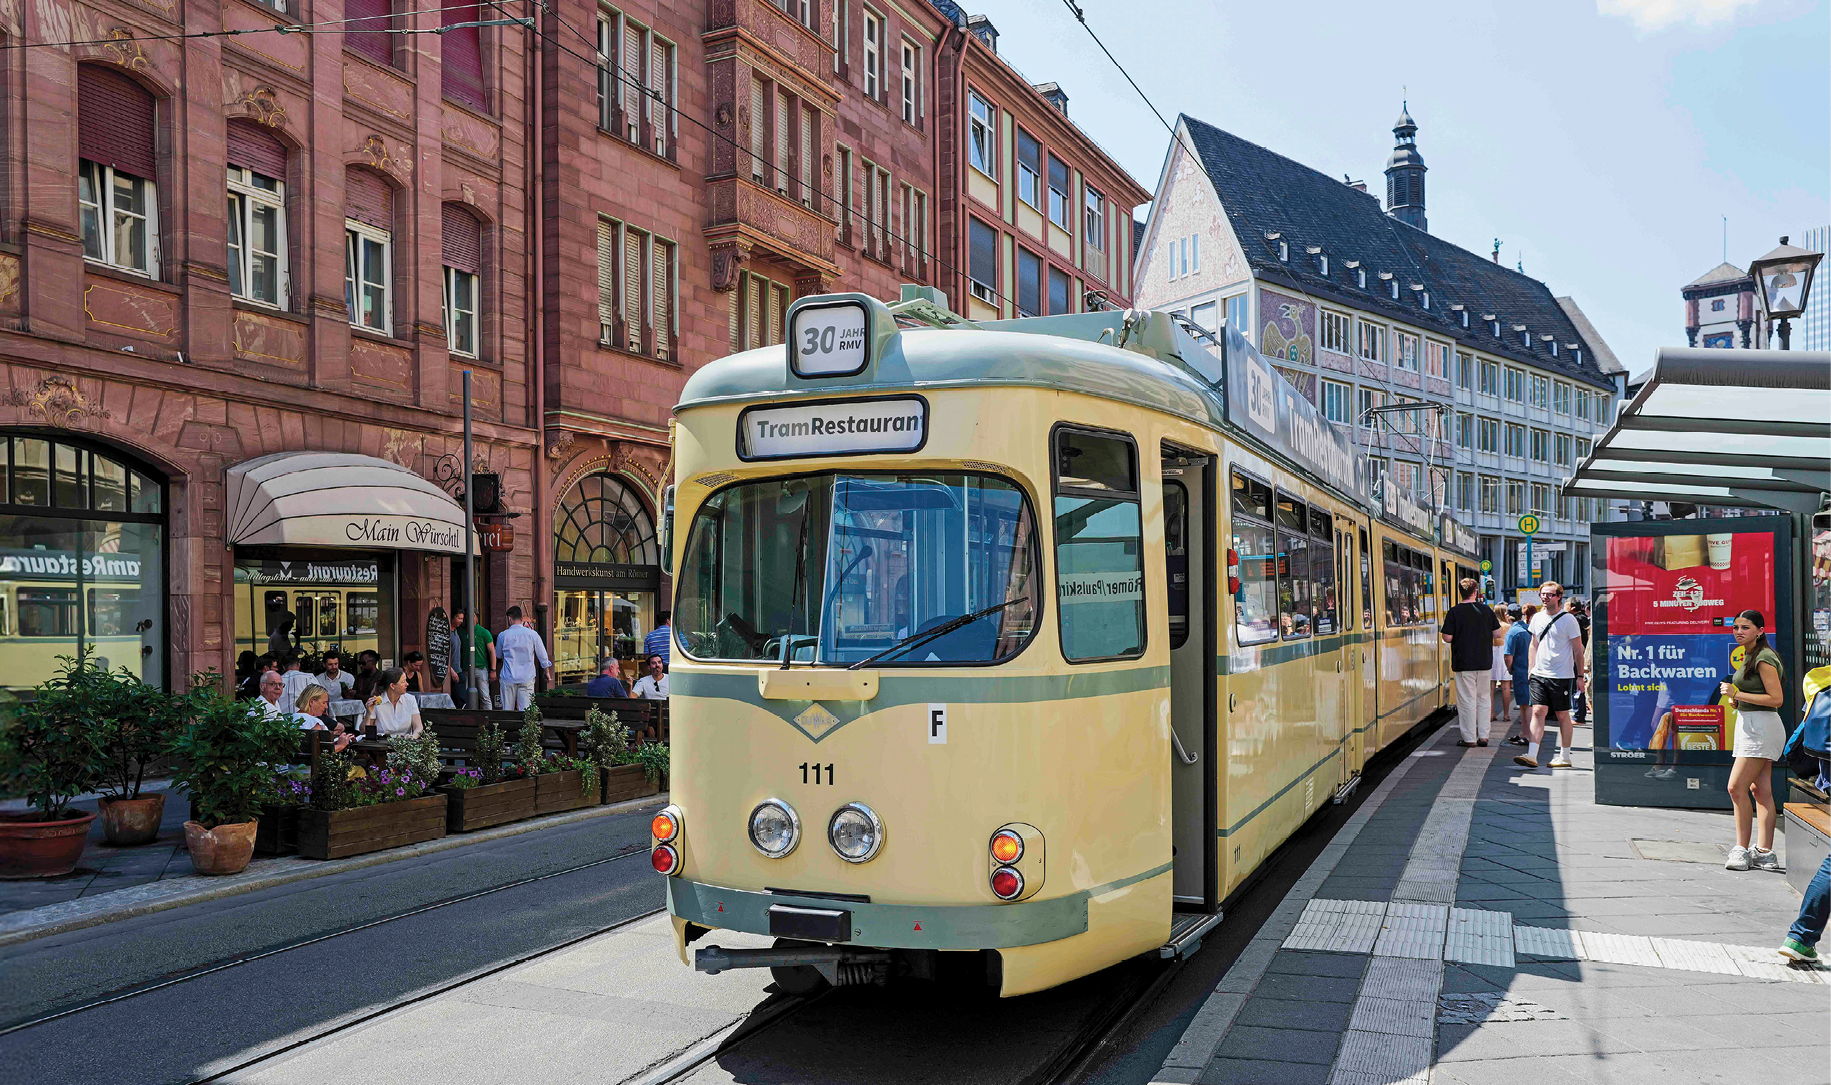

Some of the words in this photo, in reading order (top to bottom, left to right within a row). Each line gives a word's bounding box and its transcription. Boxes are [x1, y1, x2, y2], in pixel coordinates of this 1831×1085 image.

[801, 326, 836, 356] 30
[839, 340, 862, 350] RMV
[1250, 369, 1262, 416] 30
[757, 415, 922, 438] TramRestauran
[1524, 519, 1533, 530] H
[346, 518, 400, 542] Main
[405, 521, 460, 549] Würschtl
[479, 528, 501, 548] rei
[556, 565, 614, 577] Handwerkskunst
[1617, 646, 1643, 660] Nr.
[1645, 646, 1654, 660] 1
[1658, 645, 1686, 660] für
[1617, 664, 1717, 679] Backwaren
[1617, 683, 1645, 692] Lohnt
[1646, 682, 1667, 692] sich
[931, 710, 944, 737] F
[1610, 751, 1646, 759] STRÖER
[799, 762, 834, 786] 111
